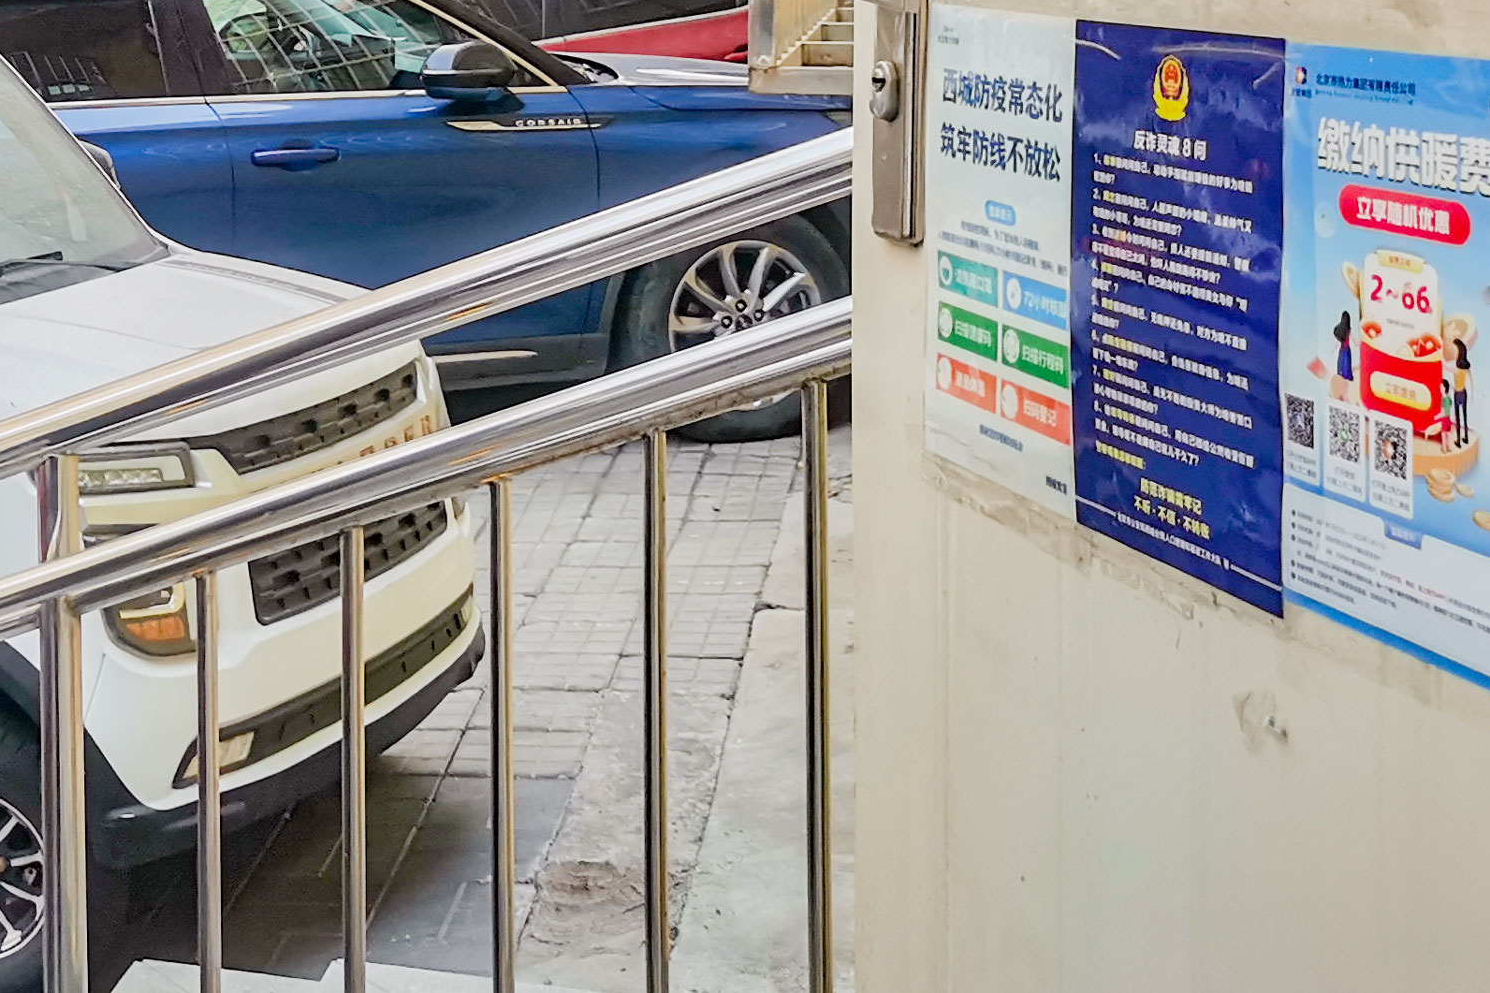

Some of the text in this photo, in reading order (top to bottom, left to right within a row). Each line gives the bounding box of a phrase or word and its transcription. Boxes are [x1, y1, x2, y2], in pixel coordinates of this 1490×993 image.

[943, 68, 1063, 123] 西城防疫常态化
[940, 122, 1061, 182] 筑牢防线不放松
[1317, 116, 1490, 198] 缴纳供暖费
[1356, 196, 1451, 236] 立享随机优惠
